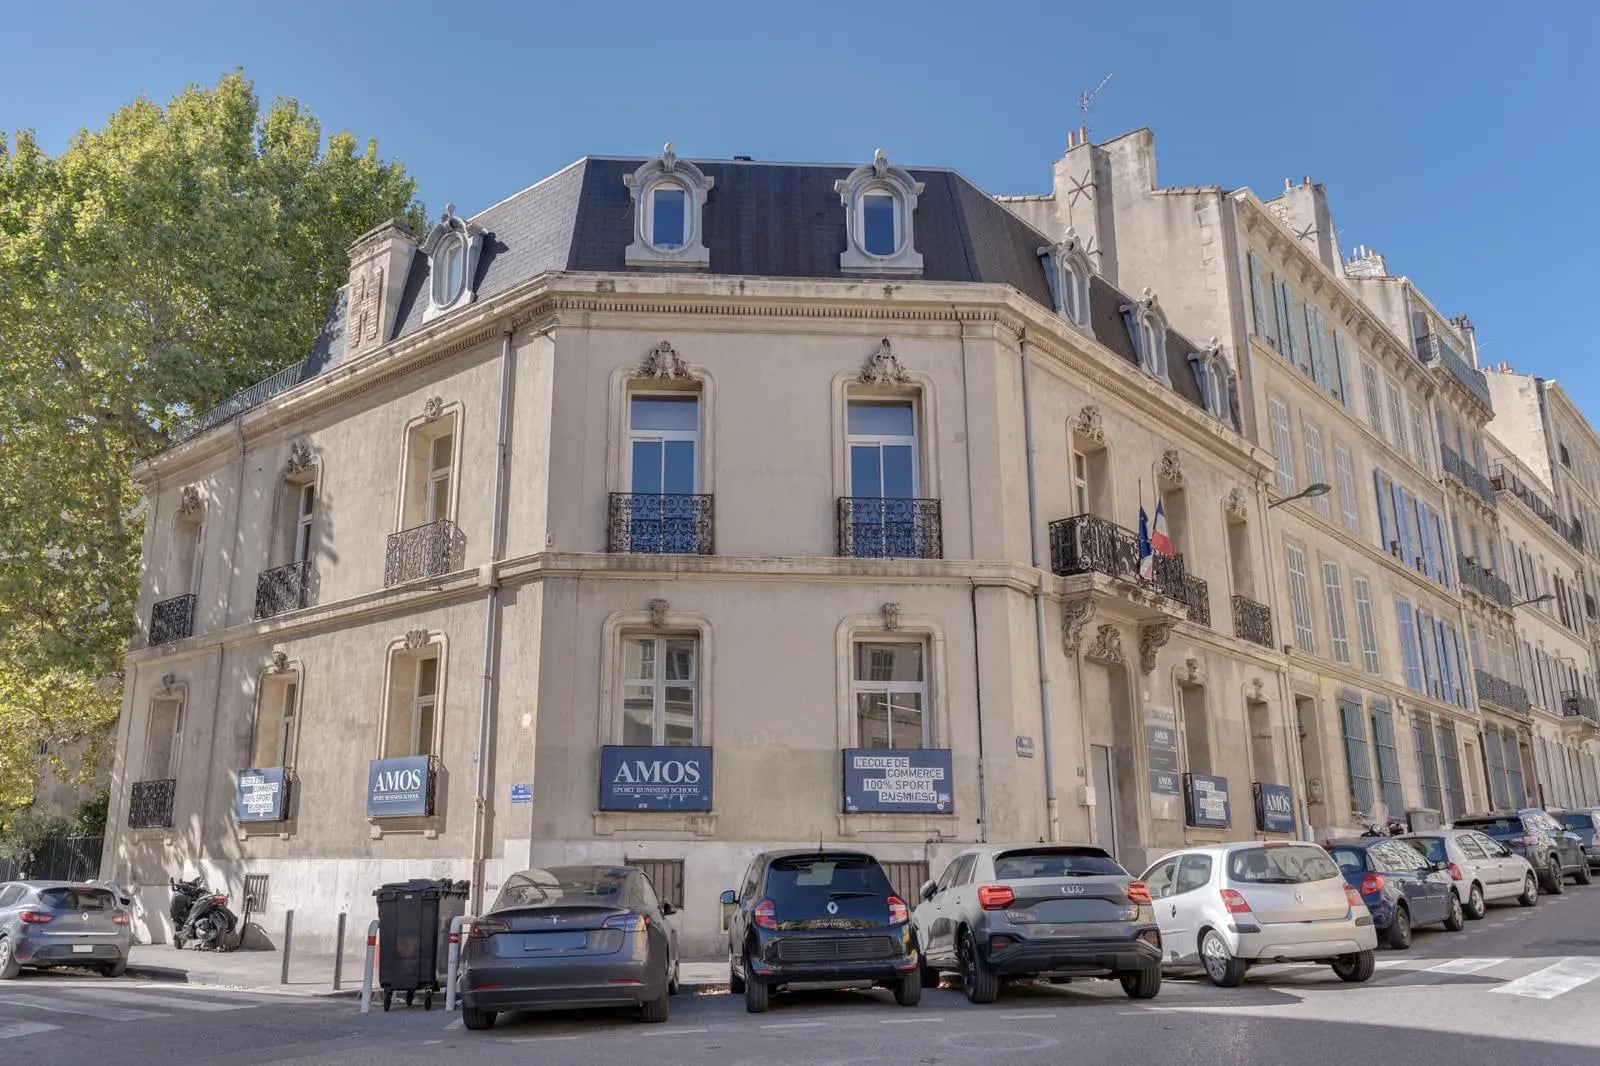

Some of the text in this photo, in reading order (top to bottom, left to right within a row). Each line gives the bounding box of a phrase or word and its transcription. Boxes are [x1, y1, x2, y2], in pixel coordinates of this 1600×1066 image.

[894, 758, 908, 768] DE
[612, 760, 701, 783] AMOS
[887, 768, 943, 779] COMMERCE
[373, 769, 420, 792] AMOS
[865, 780, 931, 790] 100% SPORT
[1266, 793, 1290, 812] AMOS
